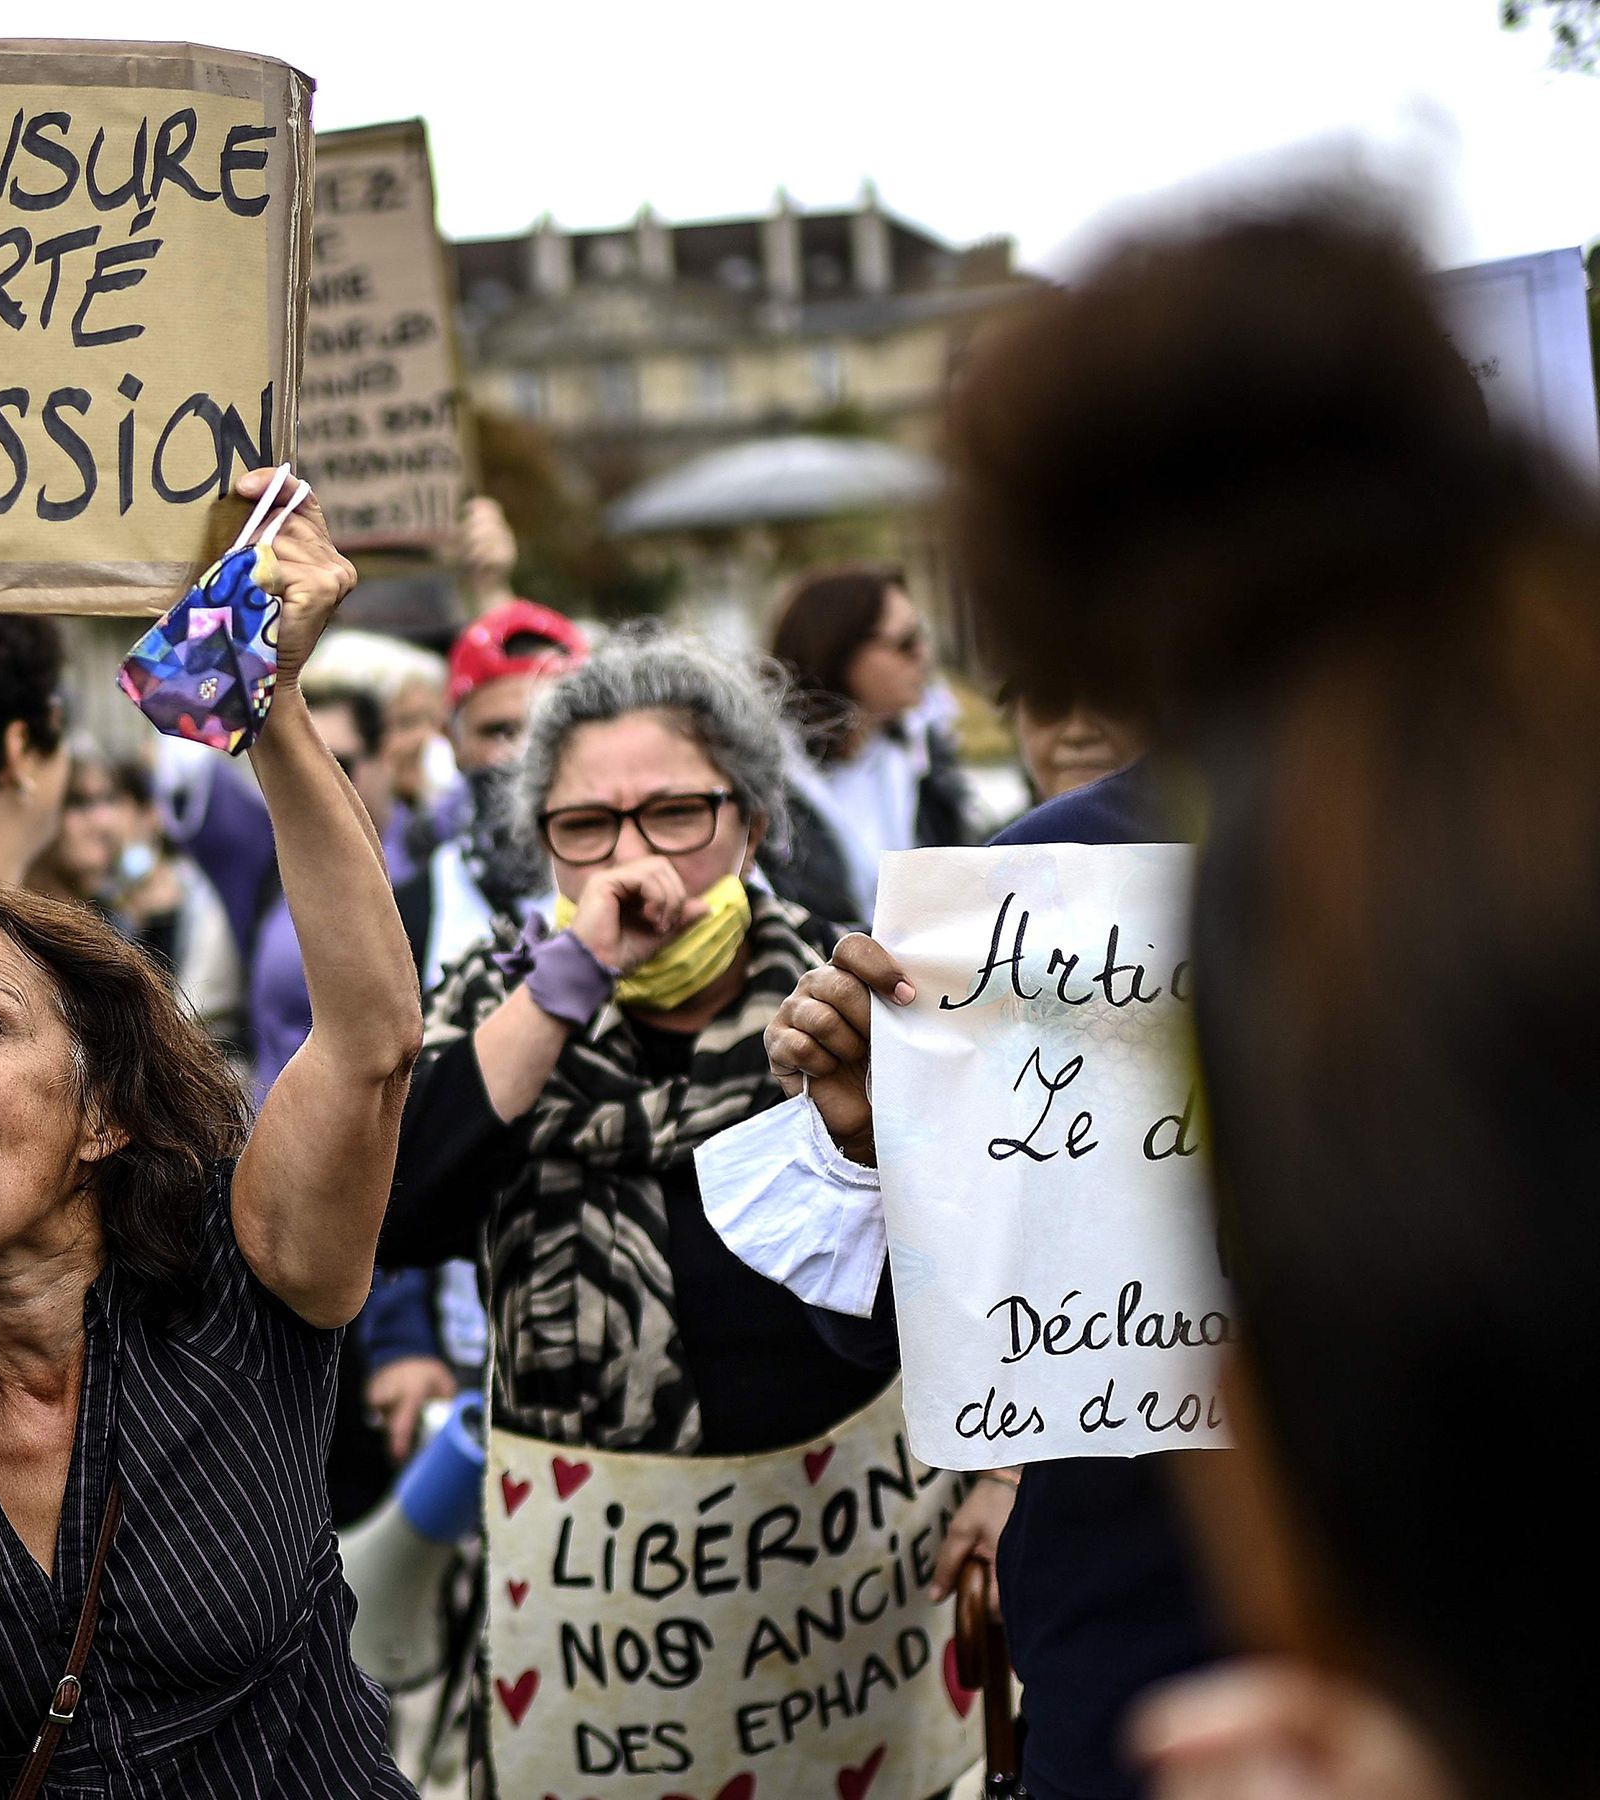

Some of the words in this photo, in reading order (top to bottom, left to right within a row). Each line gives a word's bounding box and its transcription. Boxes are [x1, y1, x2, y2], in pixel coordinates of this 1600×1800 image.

[938, 892, 1194, 1011] Artic
[1143, 1080, 1201, 1162] d
[986, 1280, 1238, 1364] Déclara
[953, 1387, 1046, 1441] des
[1079, 1378, 1223, 1436] droi
[553, 1433, 941, 1600] LiBÉRON
[575, 1721, 694, 1777] DES
[737, 1626, 931, 1757] EPHAD
